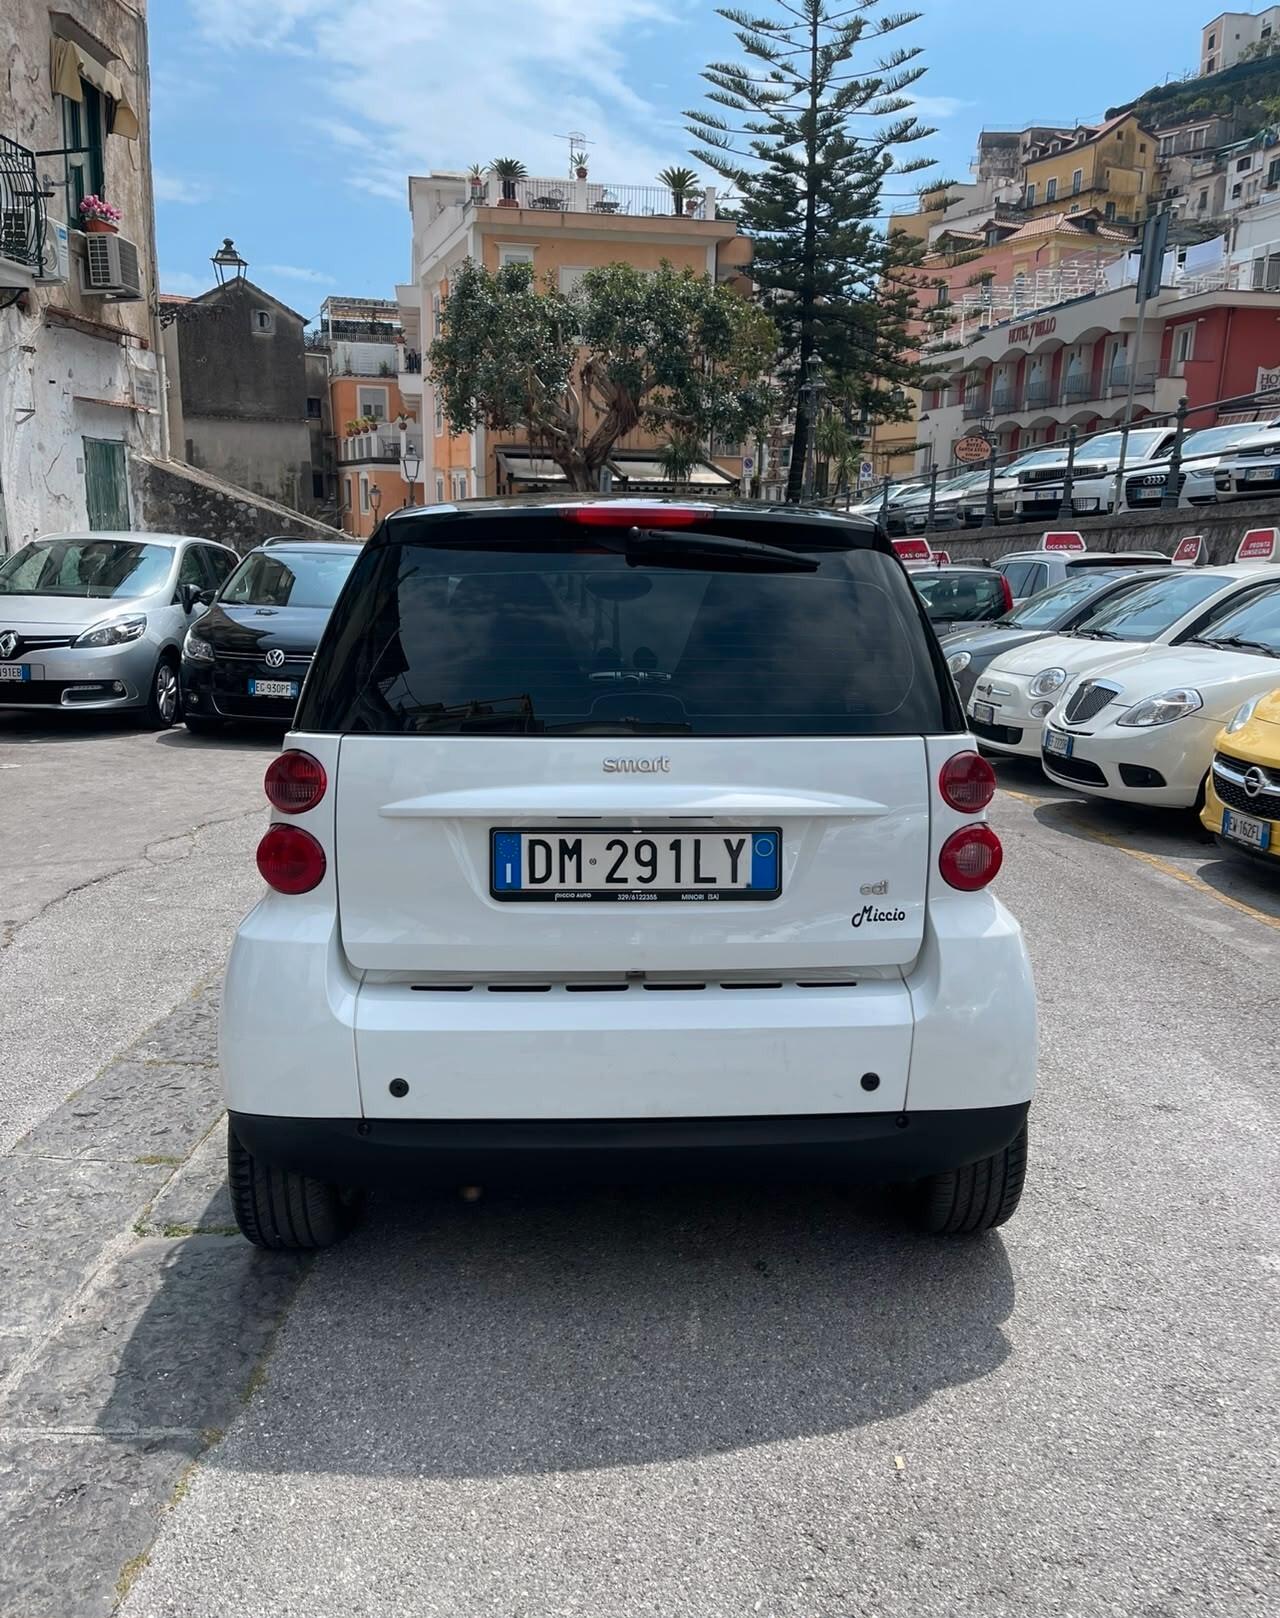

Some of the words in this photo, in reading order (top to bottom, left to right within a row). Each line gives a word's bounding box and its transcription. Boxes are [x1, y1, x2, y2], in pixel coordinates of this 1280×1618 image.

[1261, 373, 1280, 385] HO
[603, 756, 670, 773] smart
[528, 838, 583, 884] DM
[605, 839, 746, 884] 291LY
[681, 893, 705, 901] MINORI
[851, 905, 906, 928] Miccio
